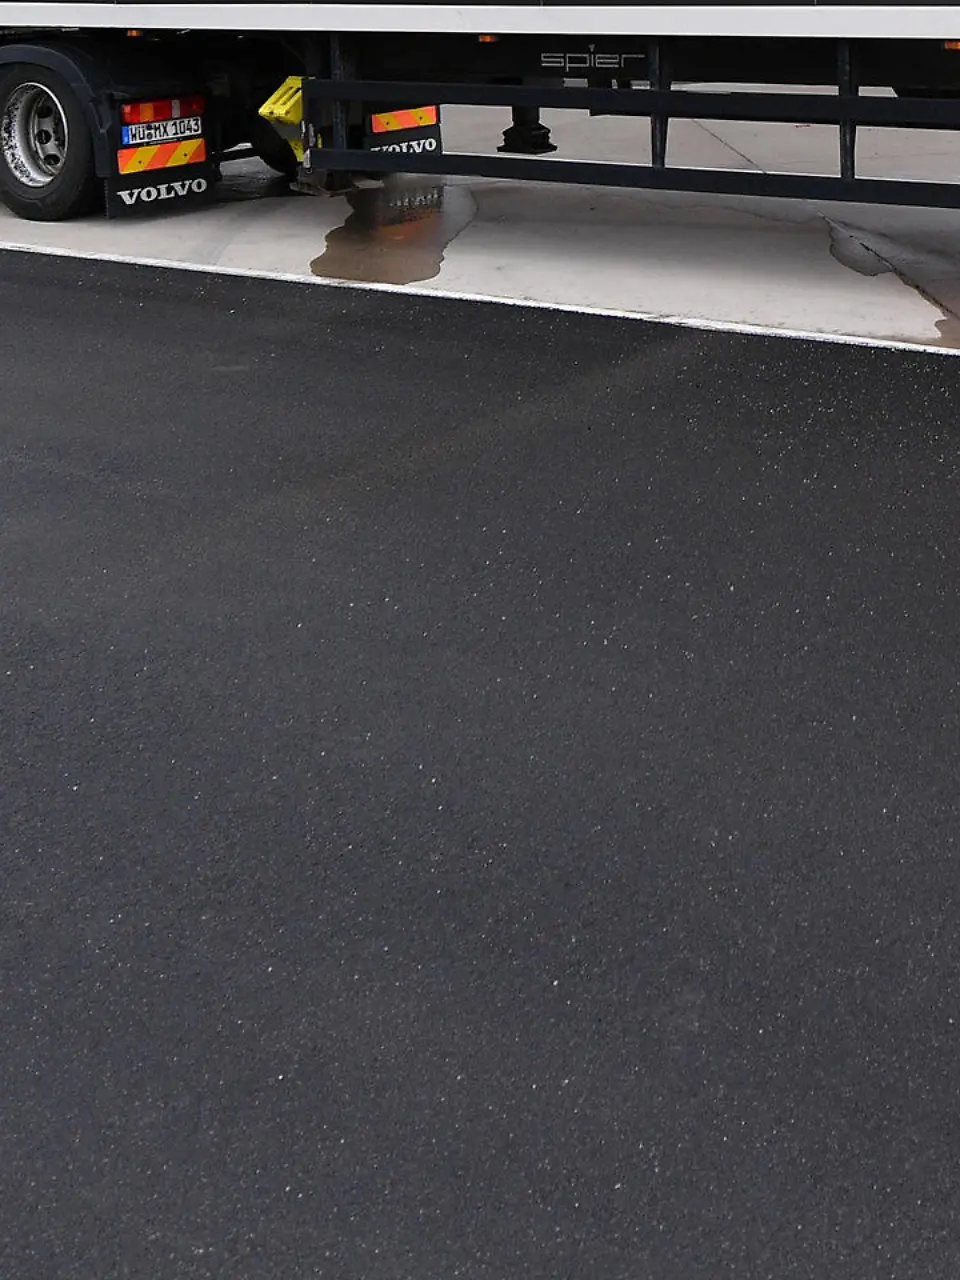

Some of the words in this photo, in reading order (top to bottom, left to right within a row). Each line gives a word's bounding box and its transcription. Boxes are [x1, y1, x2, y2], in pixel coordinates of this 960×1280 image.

[541, 44, 646, 72] spier
[171, 118, 200, 136] 1043
[117, 178, 207, 204] VOLVO
